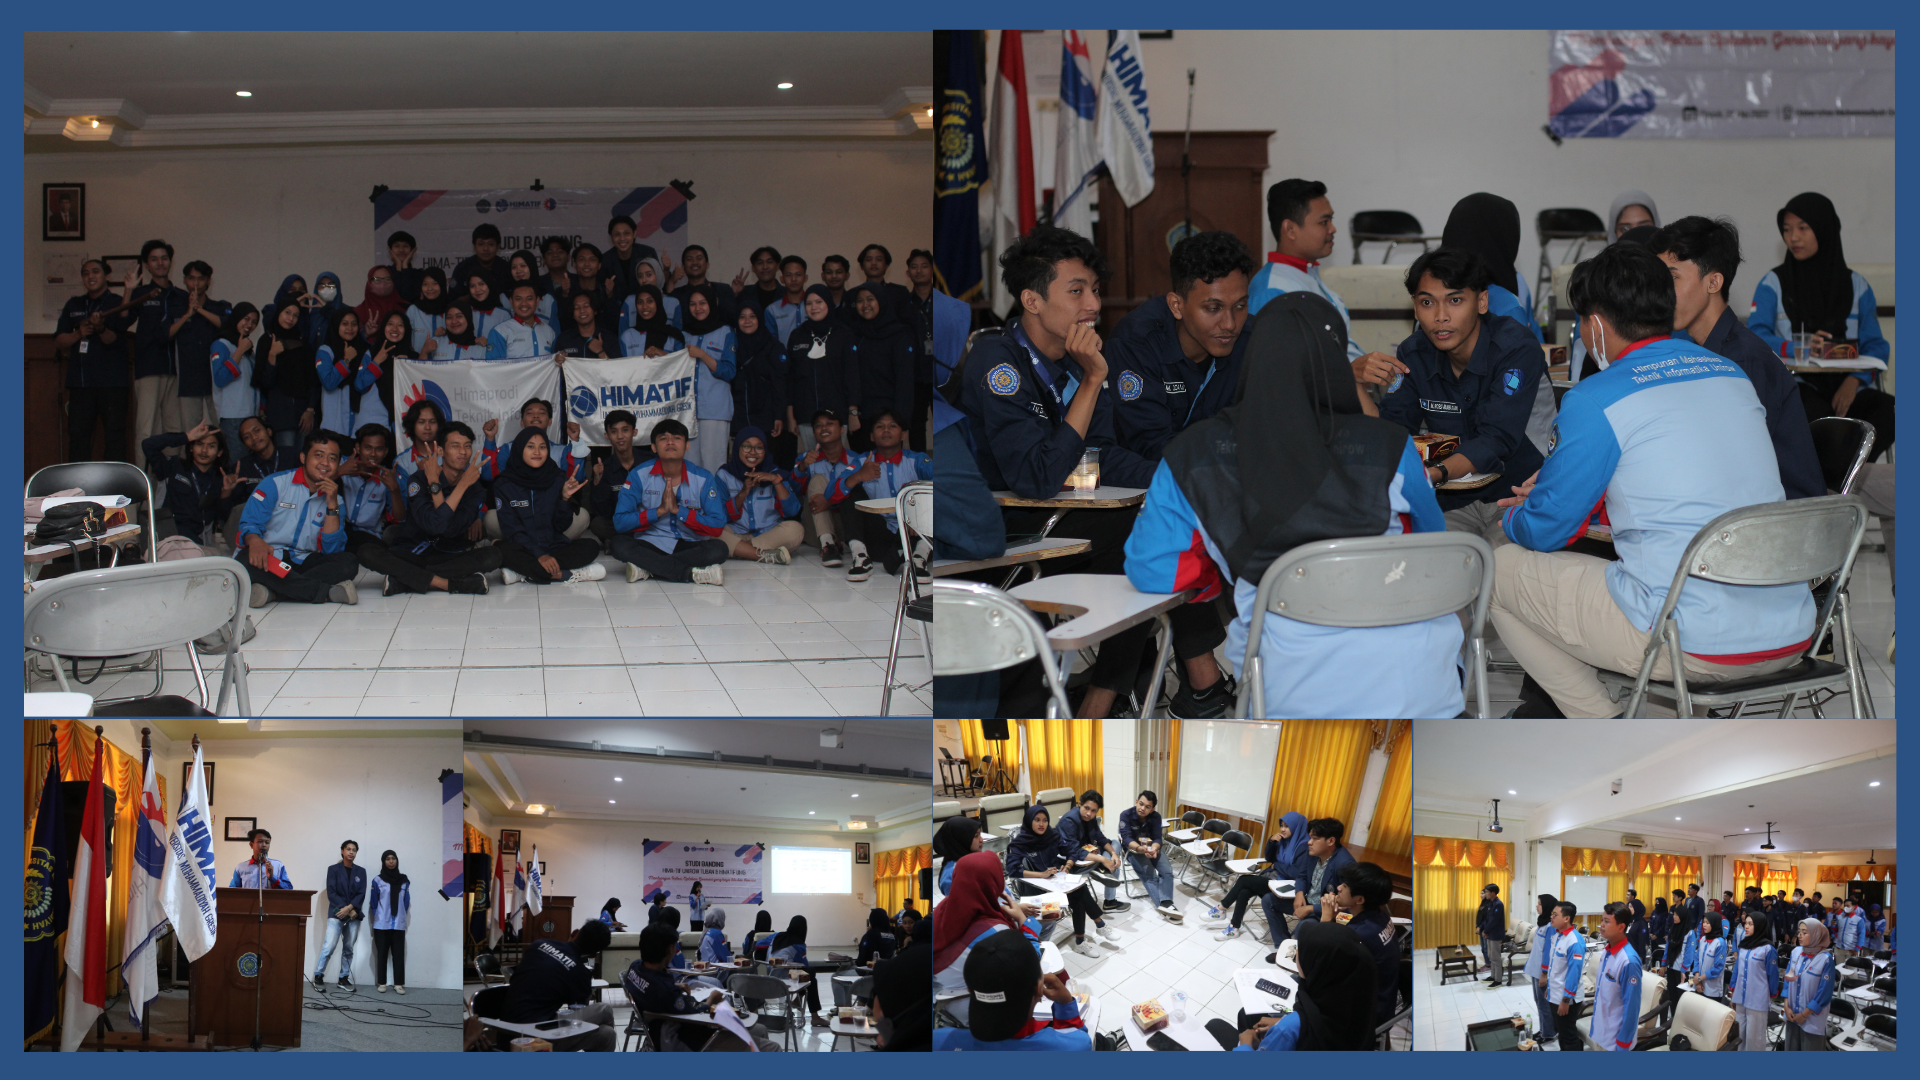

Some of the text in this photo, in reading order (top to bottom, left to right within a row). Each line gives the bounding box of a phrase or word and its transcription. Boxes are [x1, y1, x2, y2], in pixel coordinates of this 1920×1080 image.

[499, 235, 520, 250] UDI
[1631, 358, 1680, 374] Himpunan
[1631, 371, 1664, 385] Teknik
[1662, 365, 1711, 378] Informatika
[454, 386, 519, 402] Himaprodi
[601, 376, 693, 407] HIMATIF
[455, 406, 494, 423] Teknik
[179, 859, 211, 915] MUHAMMADIYAH
[539, 942, 577, 968] HIMATIF
